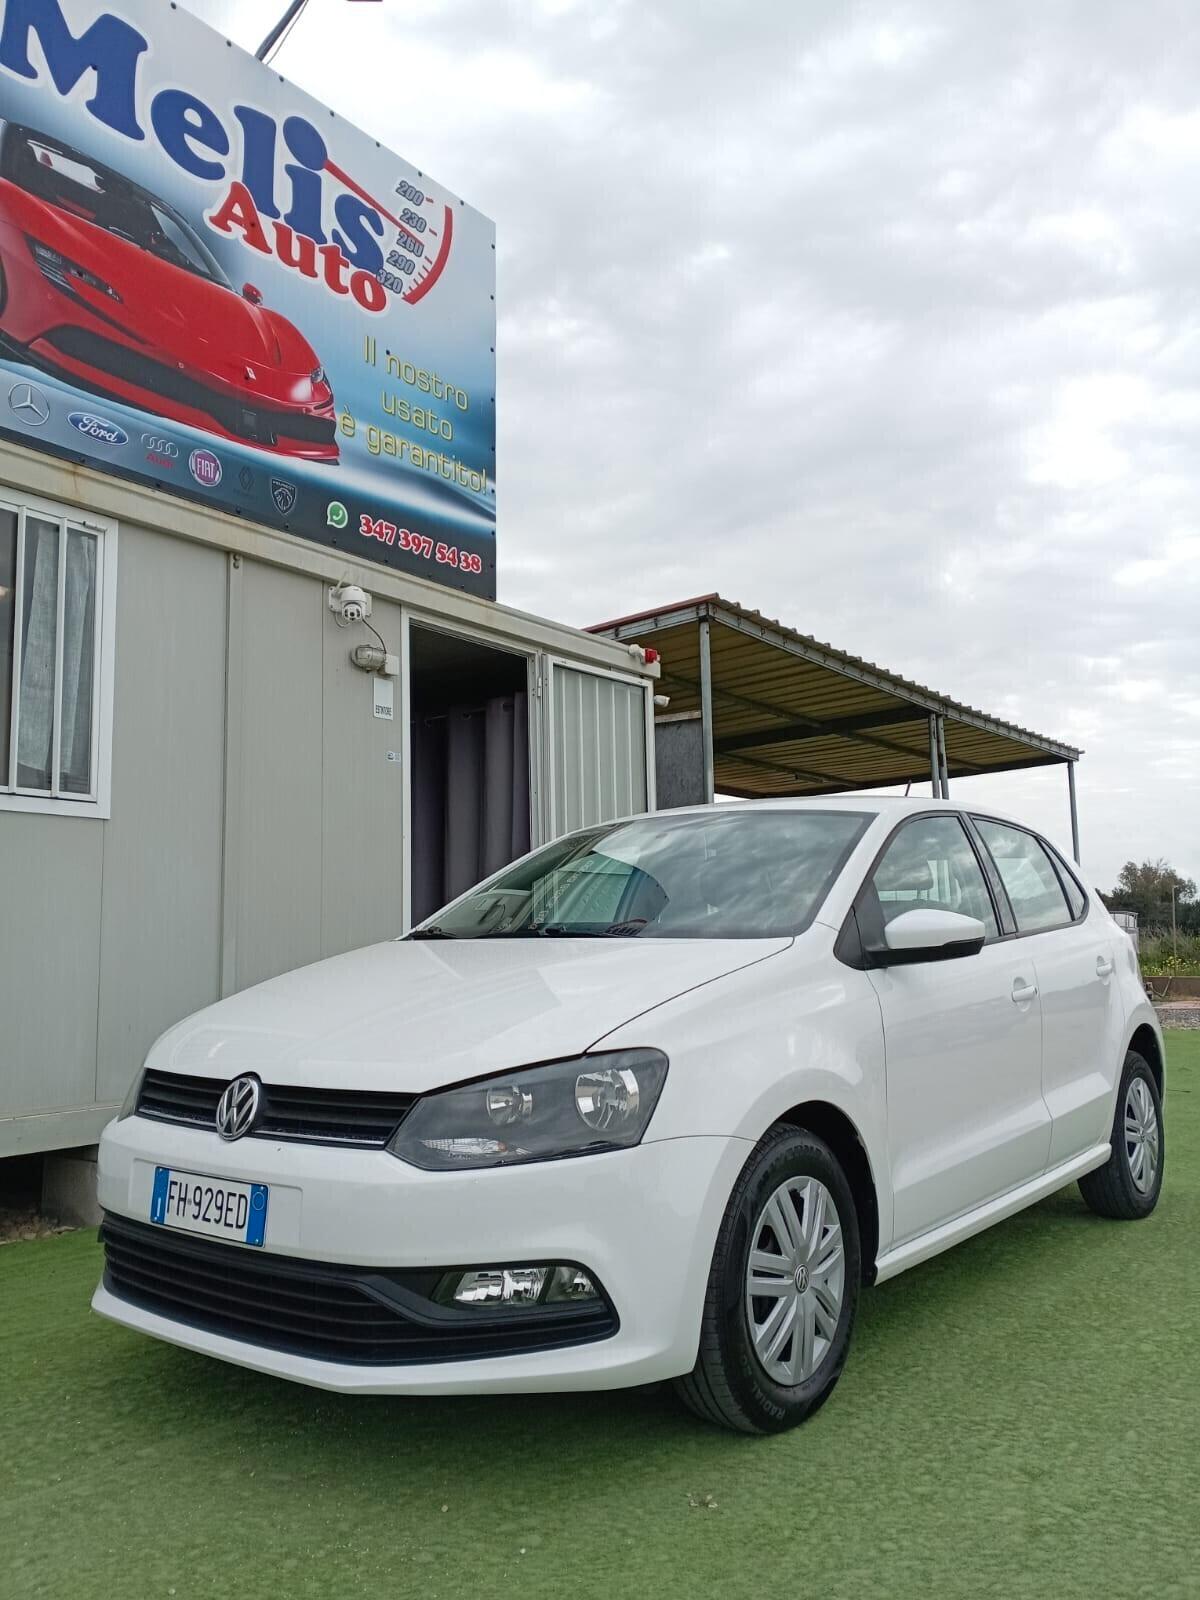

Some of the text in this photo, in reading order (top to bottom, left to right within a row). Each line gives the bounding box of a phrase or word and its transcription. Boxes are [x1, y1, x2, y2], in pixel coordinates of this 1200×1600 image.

[0, 0, 386, 274] Melis
[396, 180, 424, 206] 200
[400, 207, 427, 233] 230
[208, 180, 388, 312] Auto
[396, 230, 425, 257] 260
[386, 249, 415, 275] 290
[376, 268, 403, 294] 320
[364, 335, 469, 411] Il nostro
[78, 415, 118, 443] Ford
[381, 391, 453, 441] usato
[339, 404, 488, 495] è garantito!
[196, 457, 215, 479] FIAT
[360, 514, 397, 545] 347
[399, 529, 433, 559] 397
